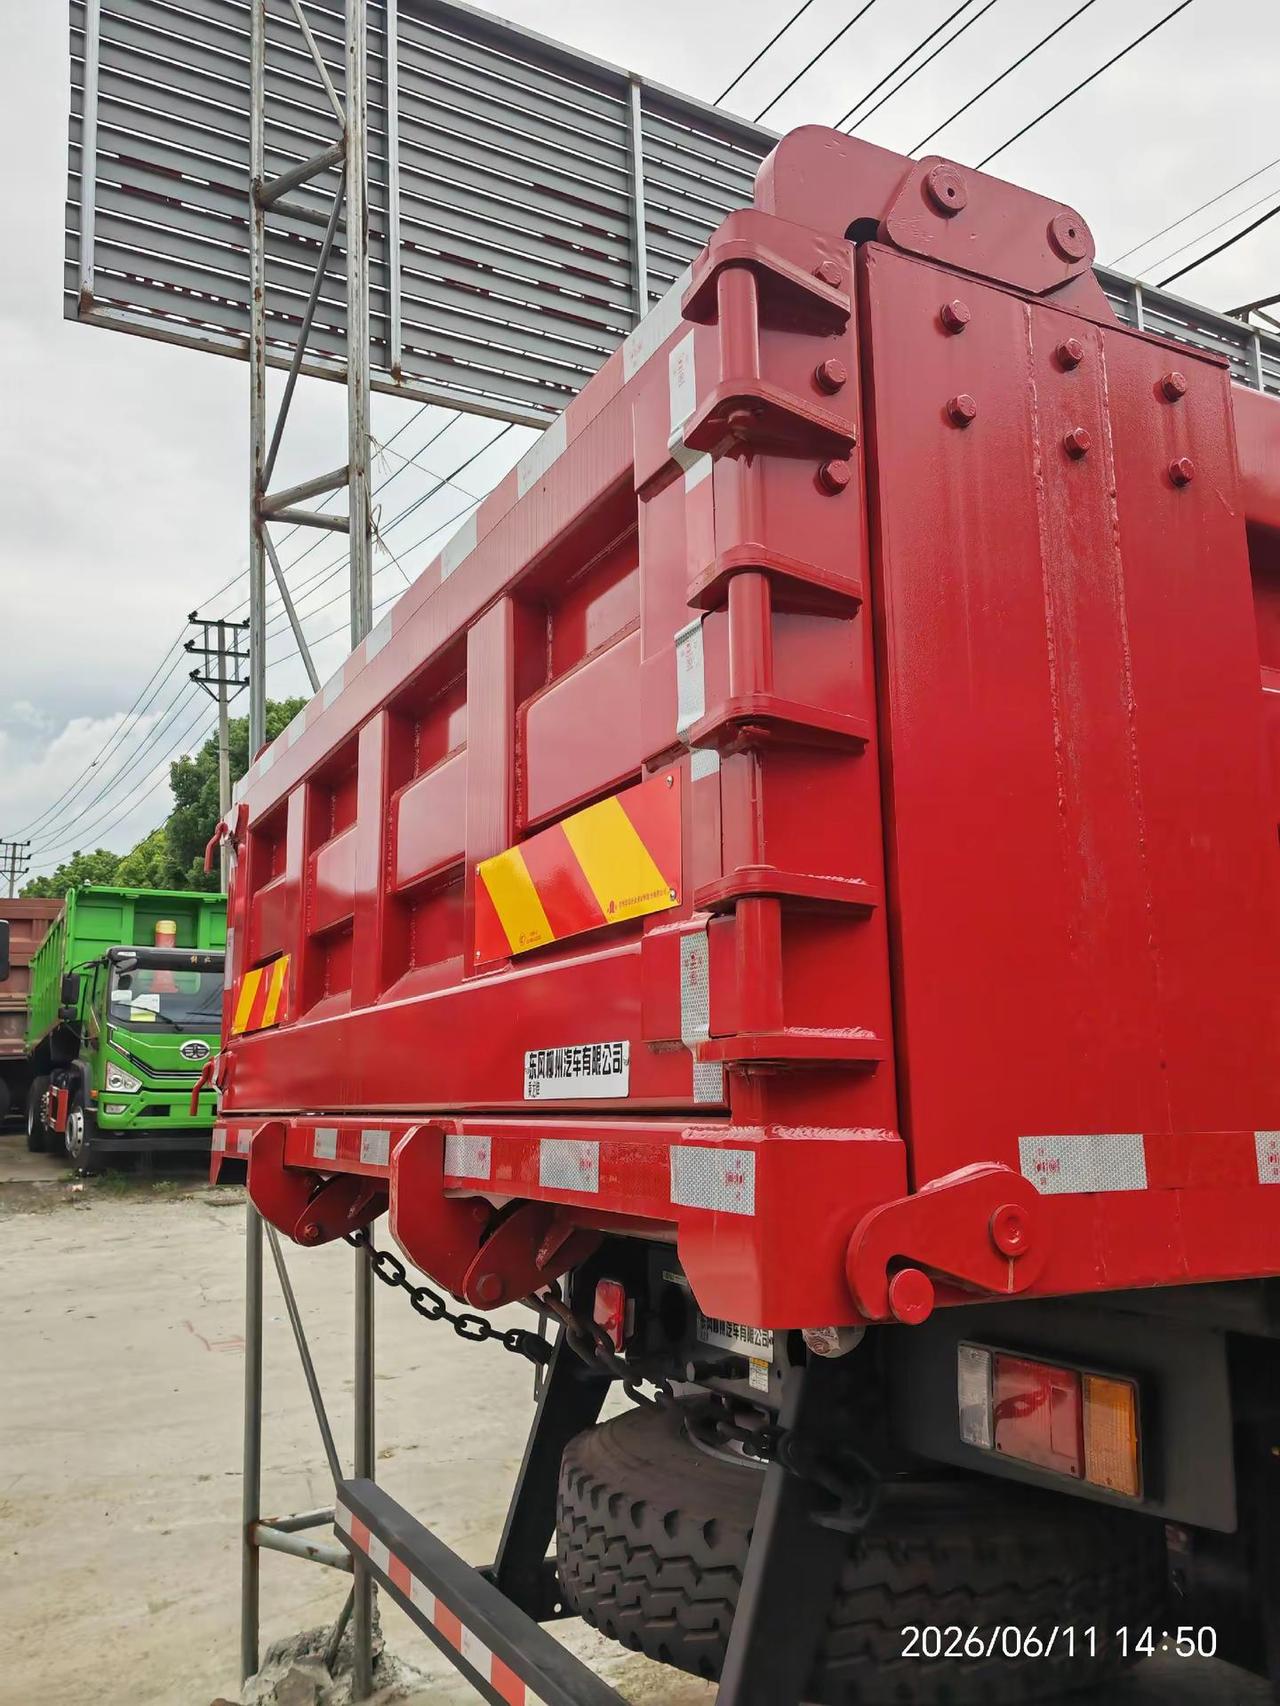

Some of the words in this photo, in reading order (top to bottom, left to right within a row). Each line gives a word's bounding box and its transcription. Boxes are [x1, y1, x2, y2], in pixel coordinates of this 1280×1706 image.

[528, 1043, 623, 1080] 东风柳州汽车有限公司
